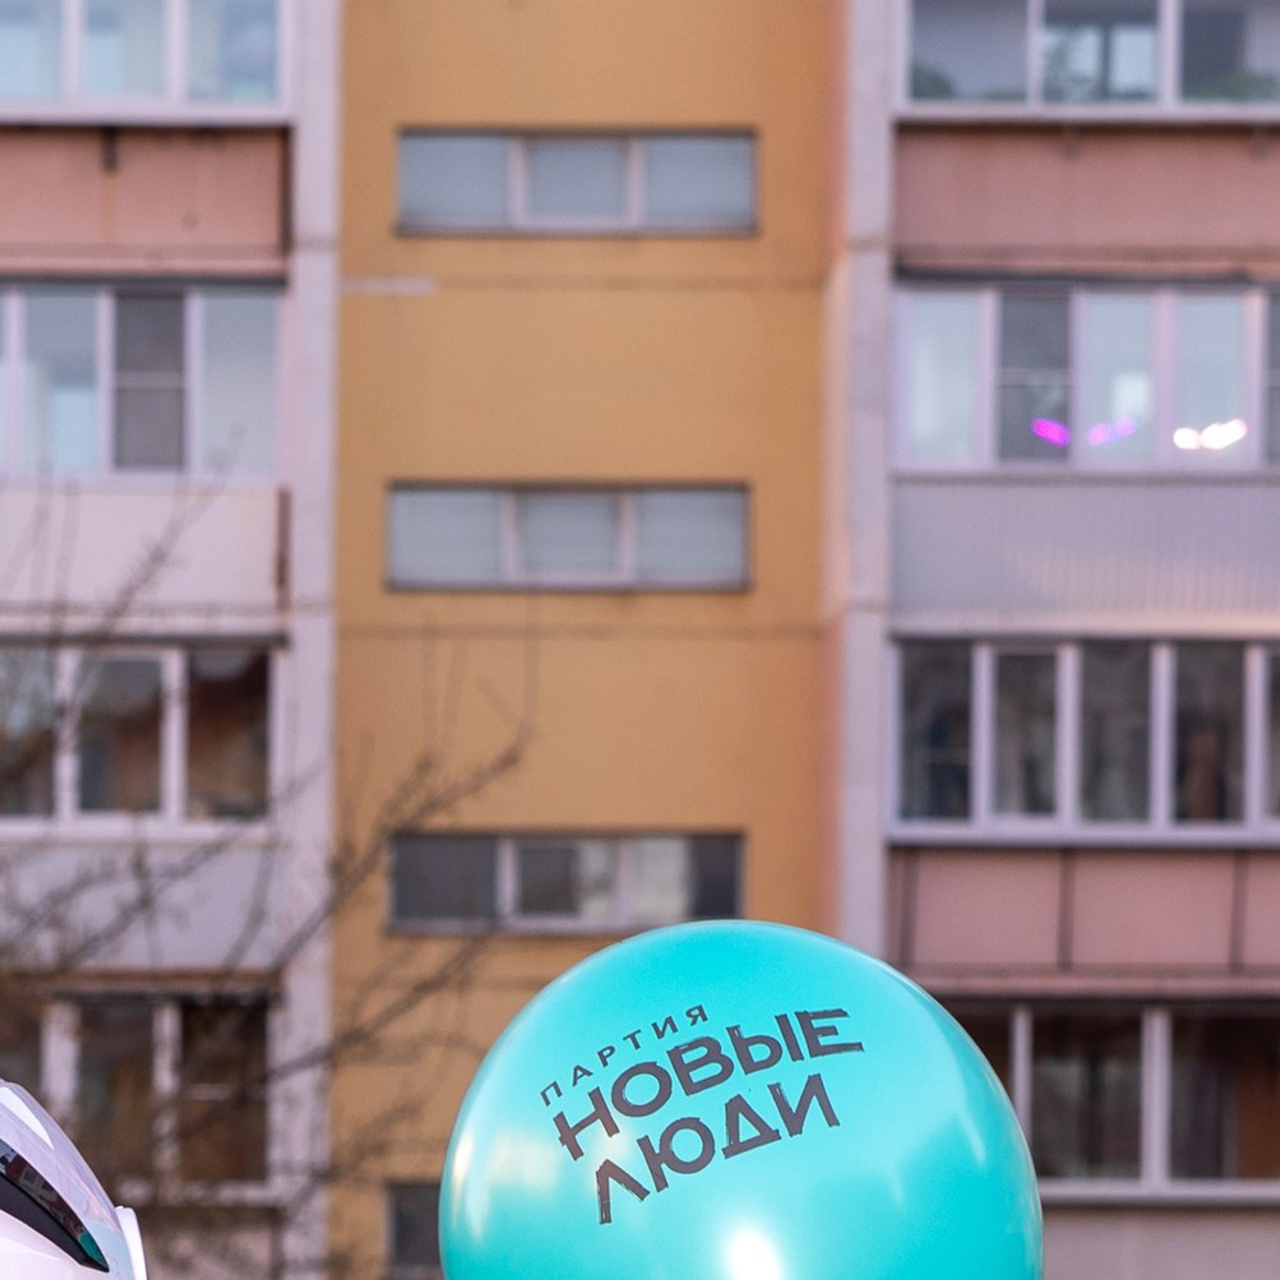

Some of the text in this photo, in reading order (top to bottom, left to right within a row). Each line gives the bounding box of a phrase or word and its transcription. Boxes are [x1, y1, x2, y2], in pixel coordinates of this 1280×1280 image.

[540, 1005, 708, 1107] ПАРТИЯ
[552, 1008, 865, 1161] НОВЫЕ
[595, 1073, 841, 1225] ЛЮДИ
